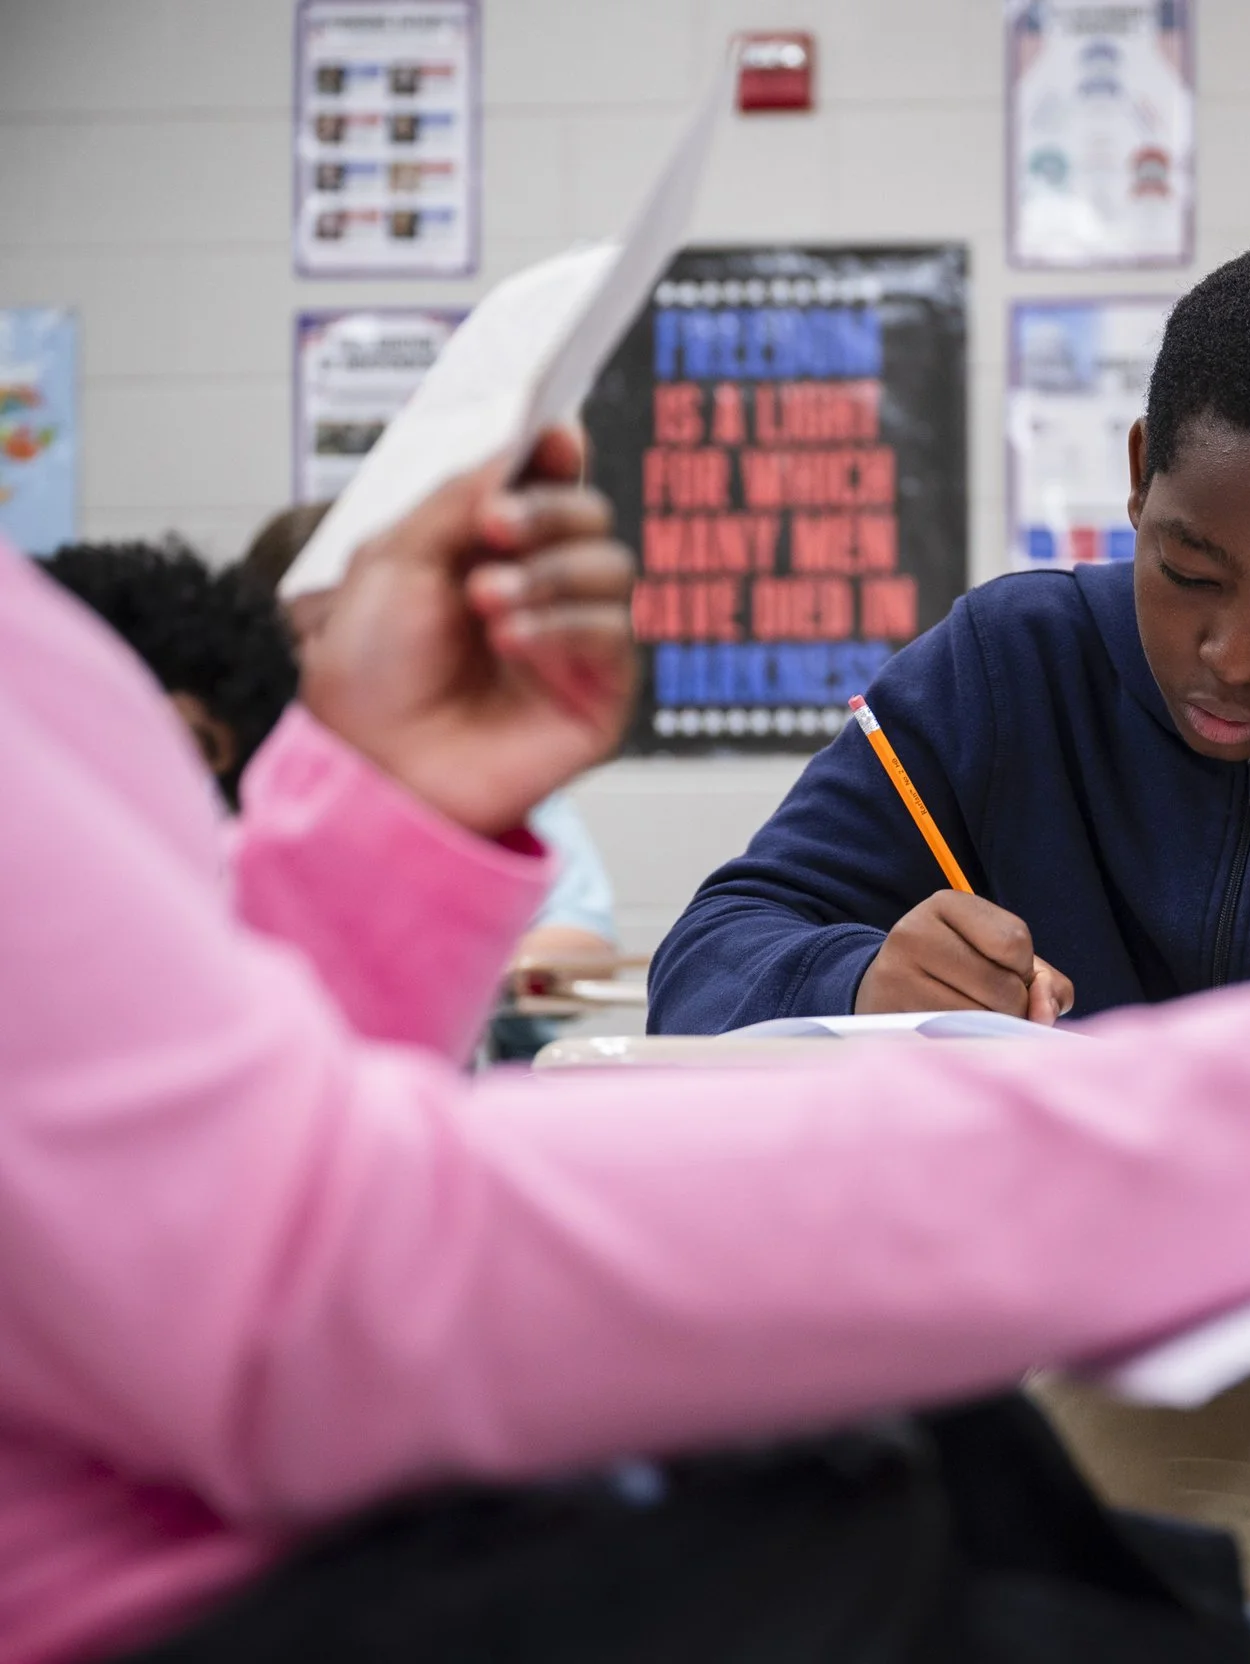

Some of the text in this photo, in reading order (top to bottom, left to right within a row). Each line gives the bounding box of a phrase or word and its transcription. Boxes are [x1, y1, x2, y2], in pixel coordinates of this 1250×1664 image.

[655, 309, 882, 378] FREEDOM
[655, 379, 879, 443] IS A LIGHT
[643, 449, 894, 508] FOR WHICH
[643, 514, 895, 572] MANY MEN
[632, 576, 916, 640] HAVE DIED IN
